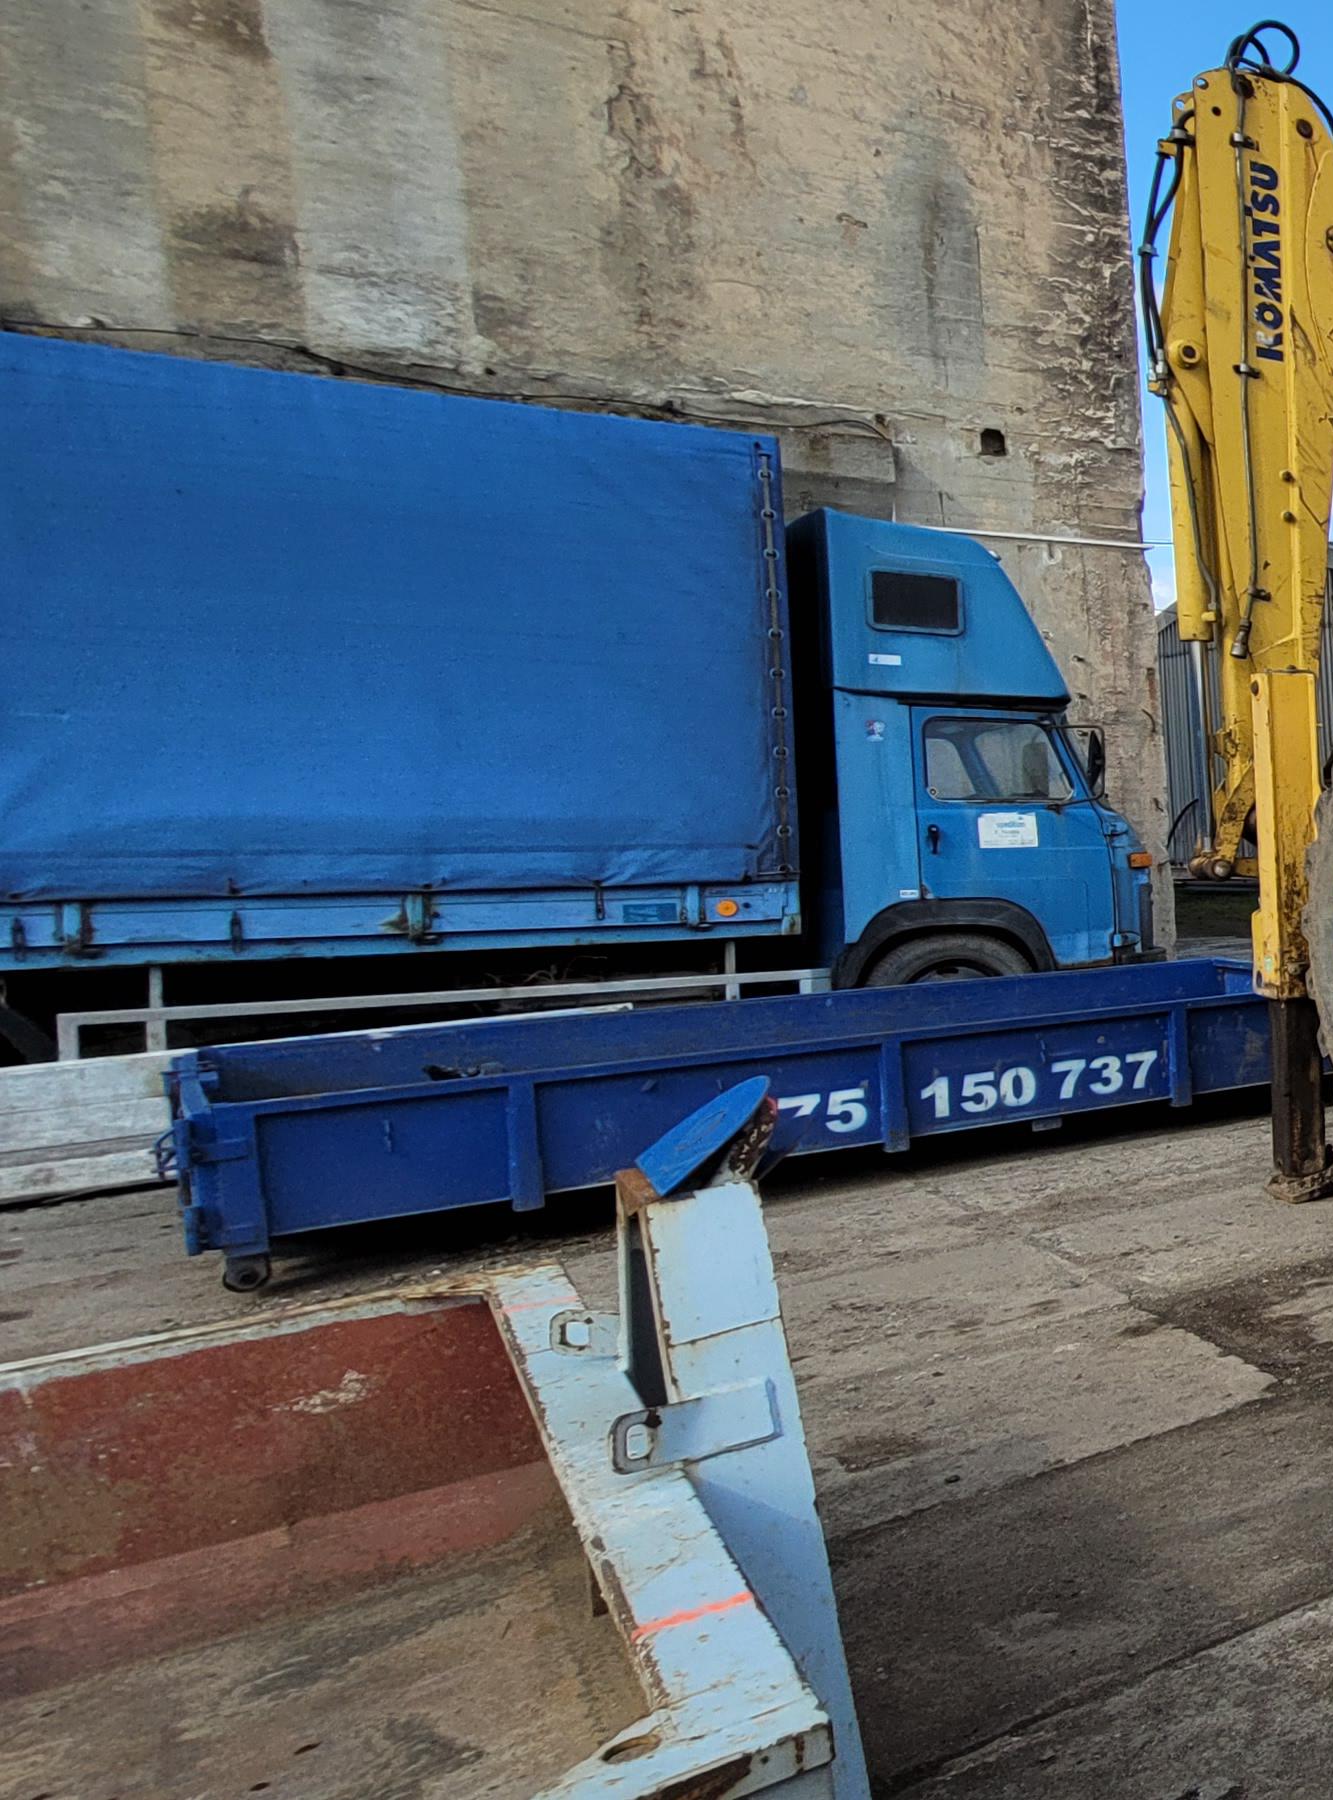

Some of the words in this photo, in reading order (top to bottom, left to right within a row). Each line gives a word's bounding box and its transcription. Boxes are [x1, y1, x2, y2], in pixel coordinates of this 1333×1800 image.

[1245, 161, 1284, 362] KOMATSU
[920, 1067, 1037, 1119] 150
[1051, 1050, 1159, 1100] 737
